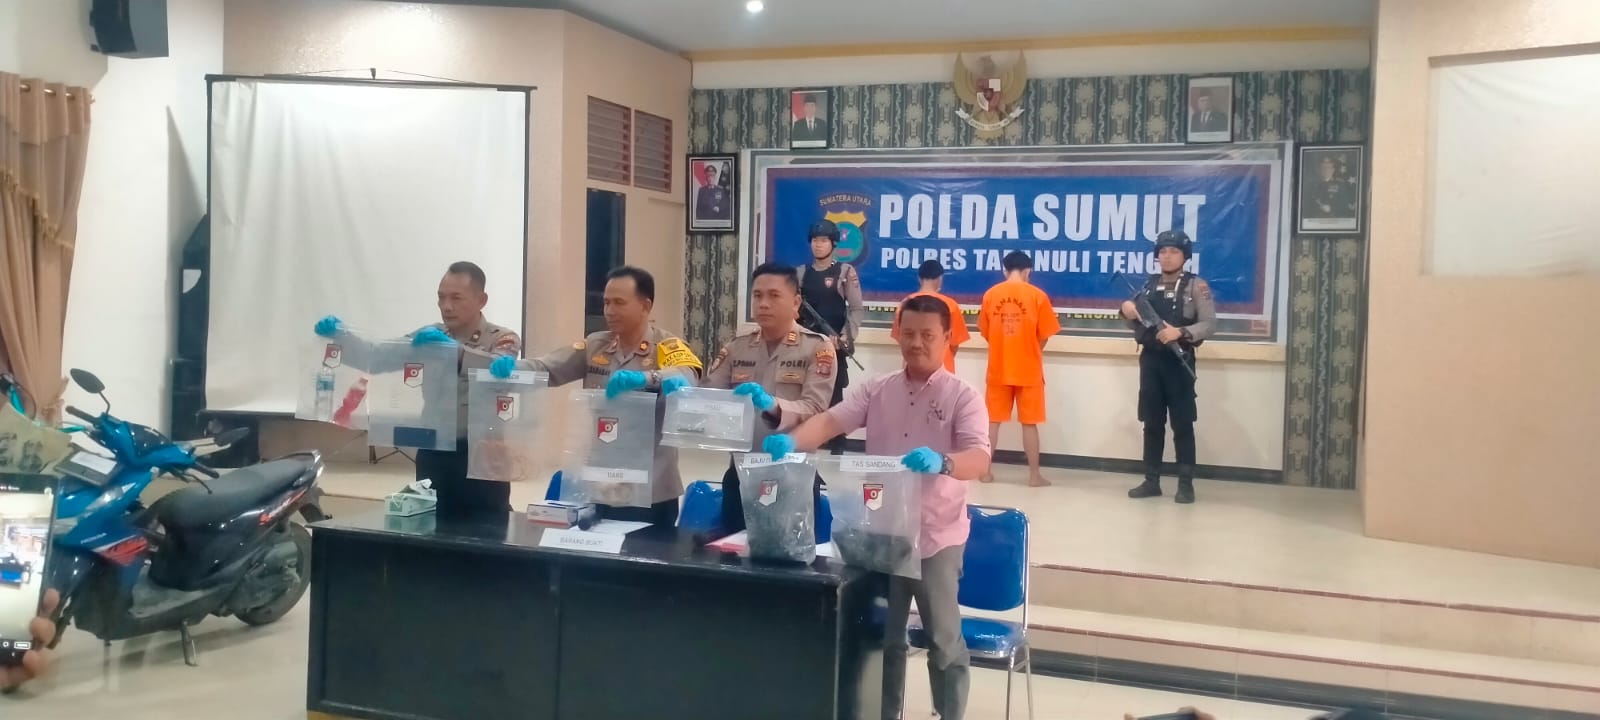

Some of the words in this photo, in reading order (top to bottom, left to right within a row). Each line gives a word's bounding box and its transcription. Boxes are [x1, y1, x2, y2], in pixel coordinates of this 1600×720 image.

[819, 193, 851, 206] SUMATERA
[852, 194, 872, 206] UTARA
[878, 193, 1019, 240] POLDA
[1032, 193, 1207, 242] SUMUT
[973, 249, 1090, 273] TANULI
